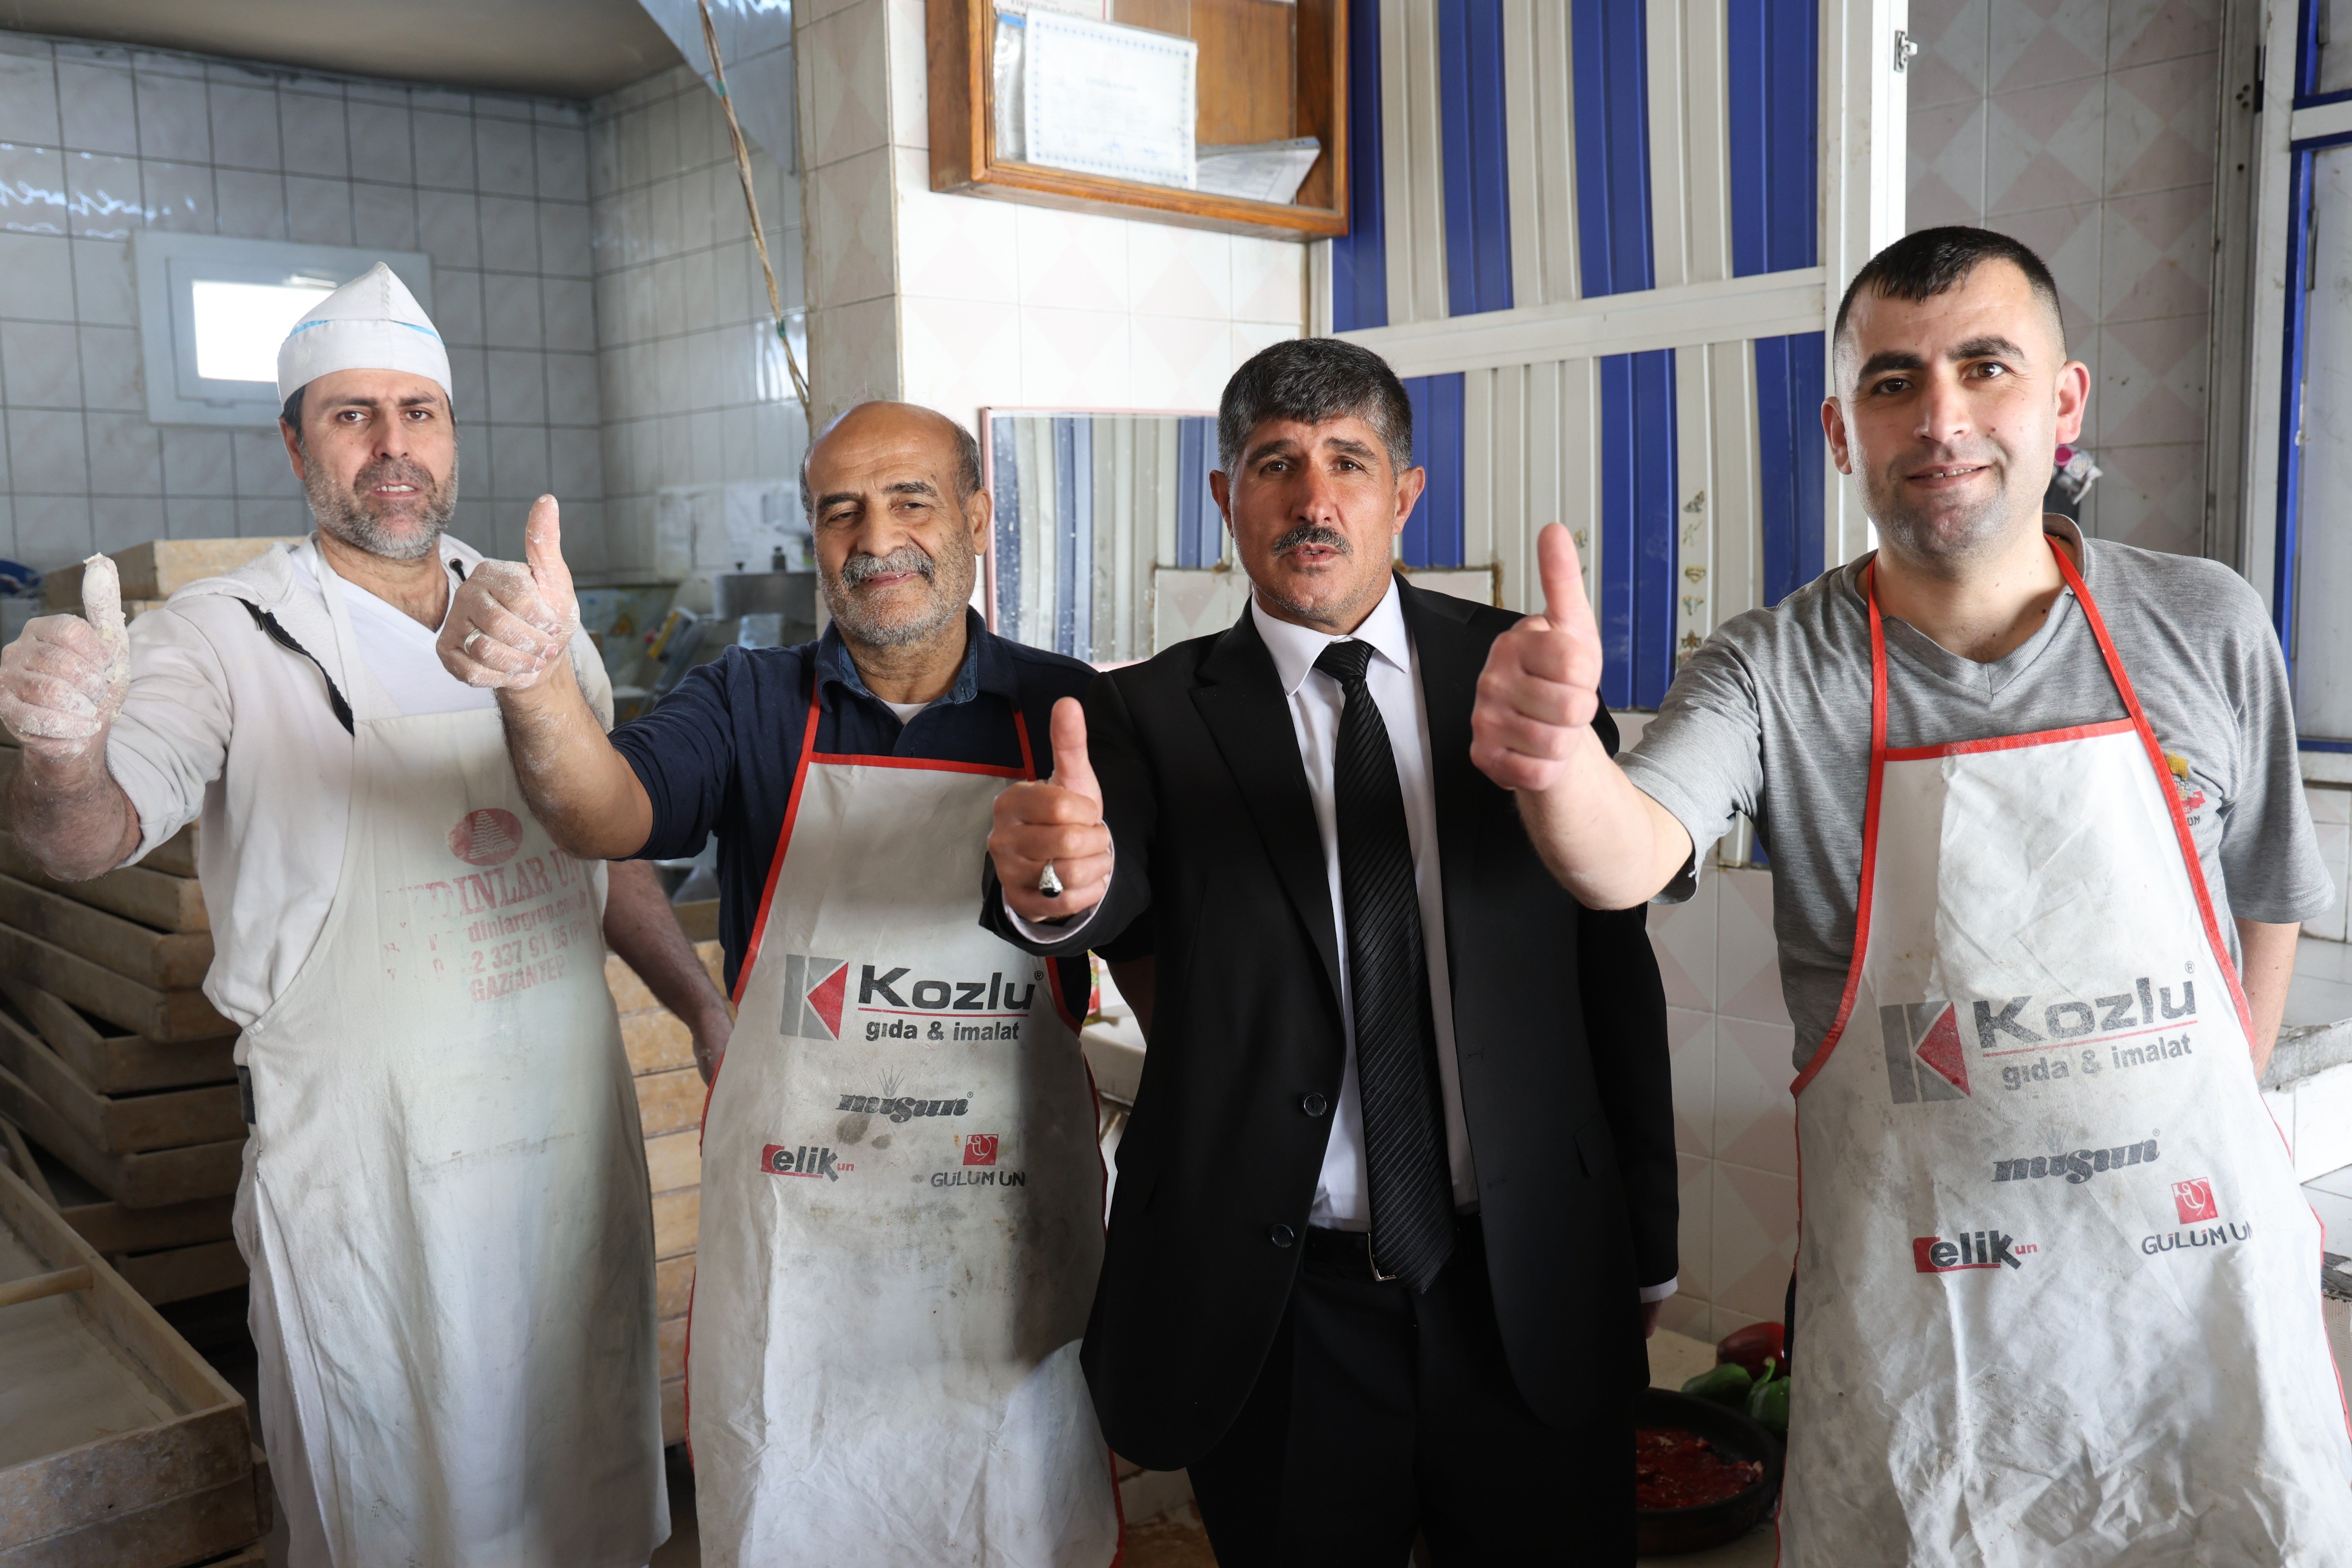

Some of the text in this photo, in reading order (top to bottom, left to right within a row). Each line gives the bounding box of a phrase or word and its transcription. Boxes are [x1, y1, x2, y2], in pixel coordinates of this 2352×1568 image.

[490, 940, 523, 969] 337
[858, 964, 1036, 1010] Kozlu
[1972, 977, 2196, 1049] Kozlu
[927, 1021, 944, 1041] &
[953, 1021, 1019, 1041] imalat
[2081, 1049, 2103, 1075] &
[2111, 1032, 2192, 1069] imalat
[837, 1163, 855, 1171] un
[999, 1171, 1025, 1186] UN
[2014, 1243, 2038, 1255] un
